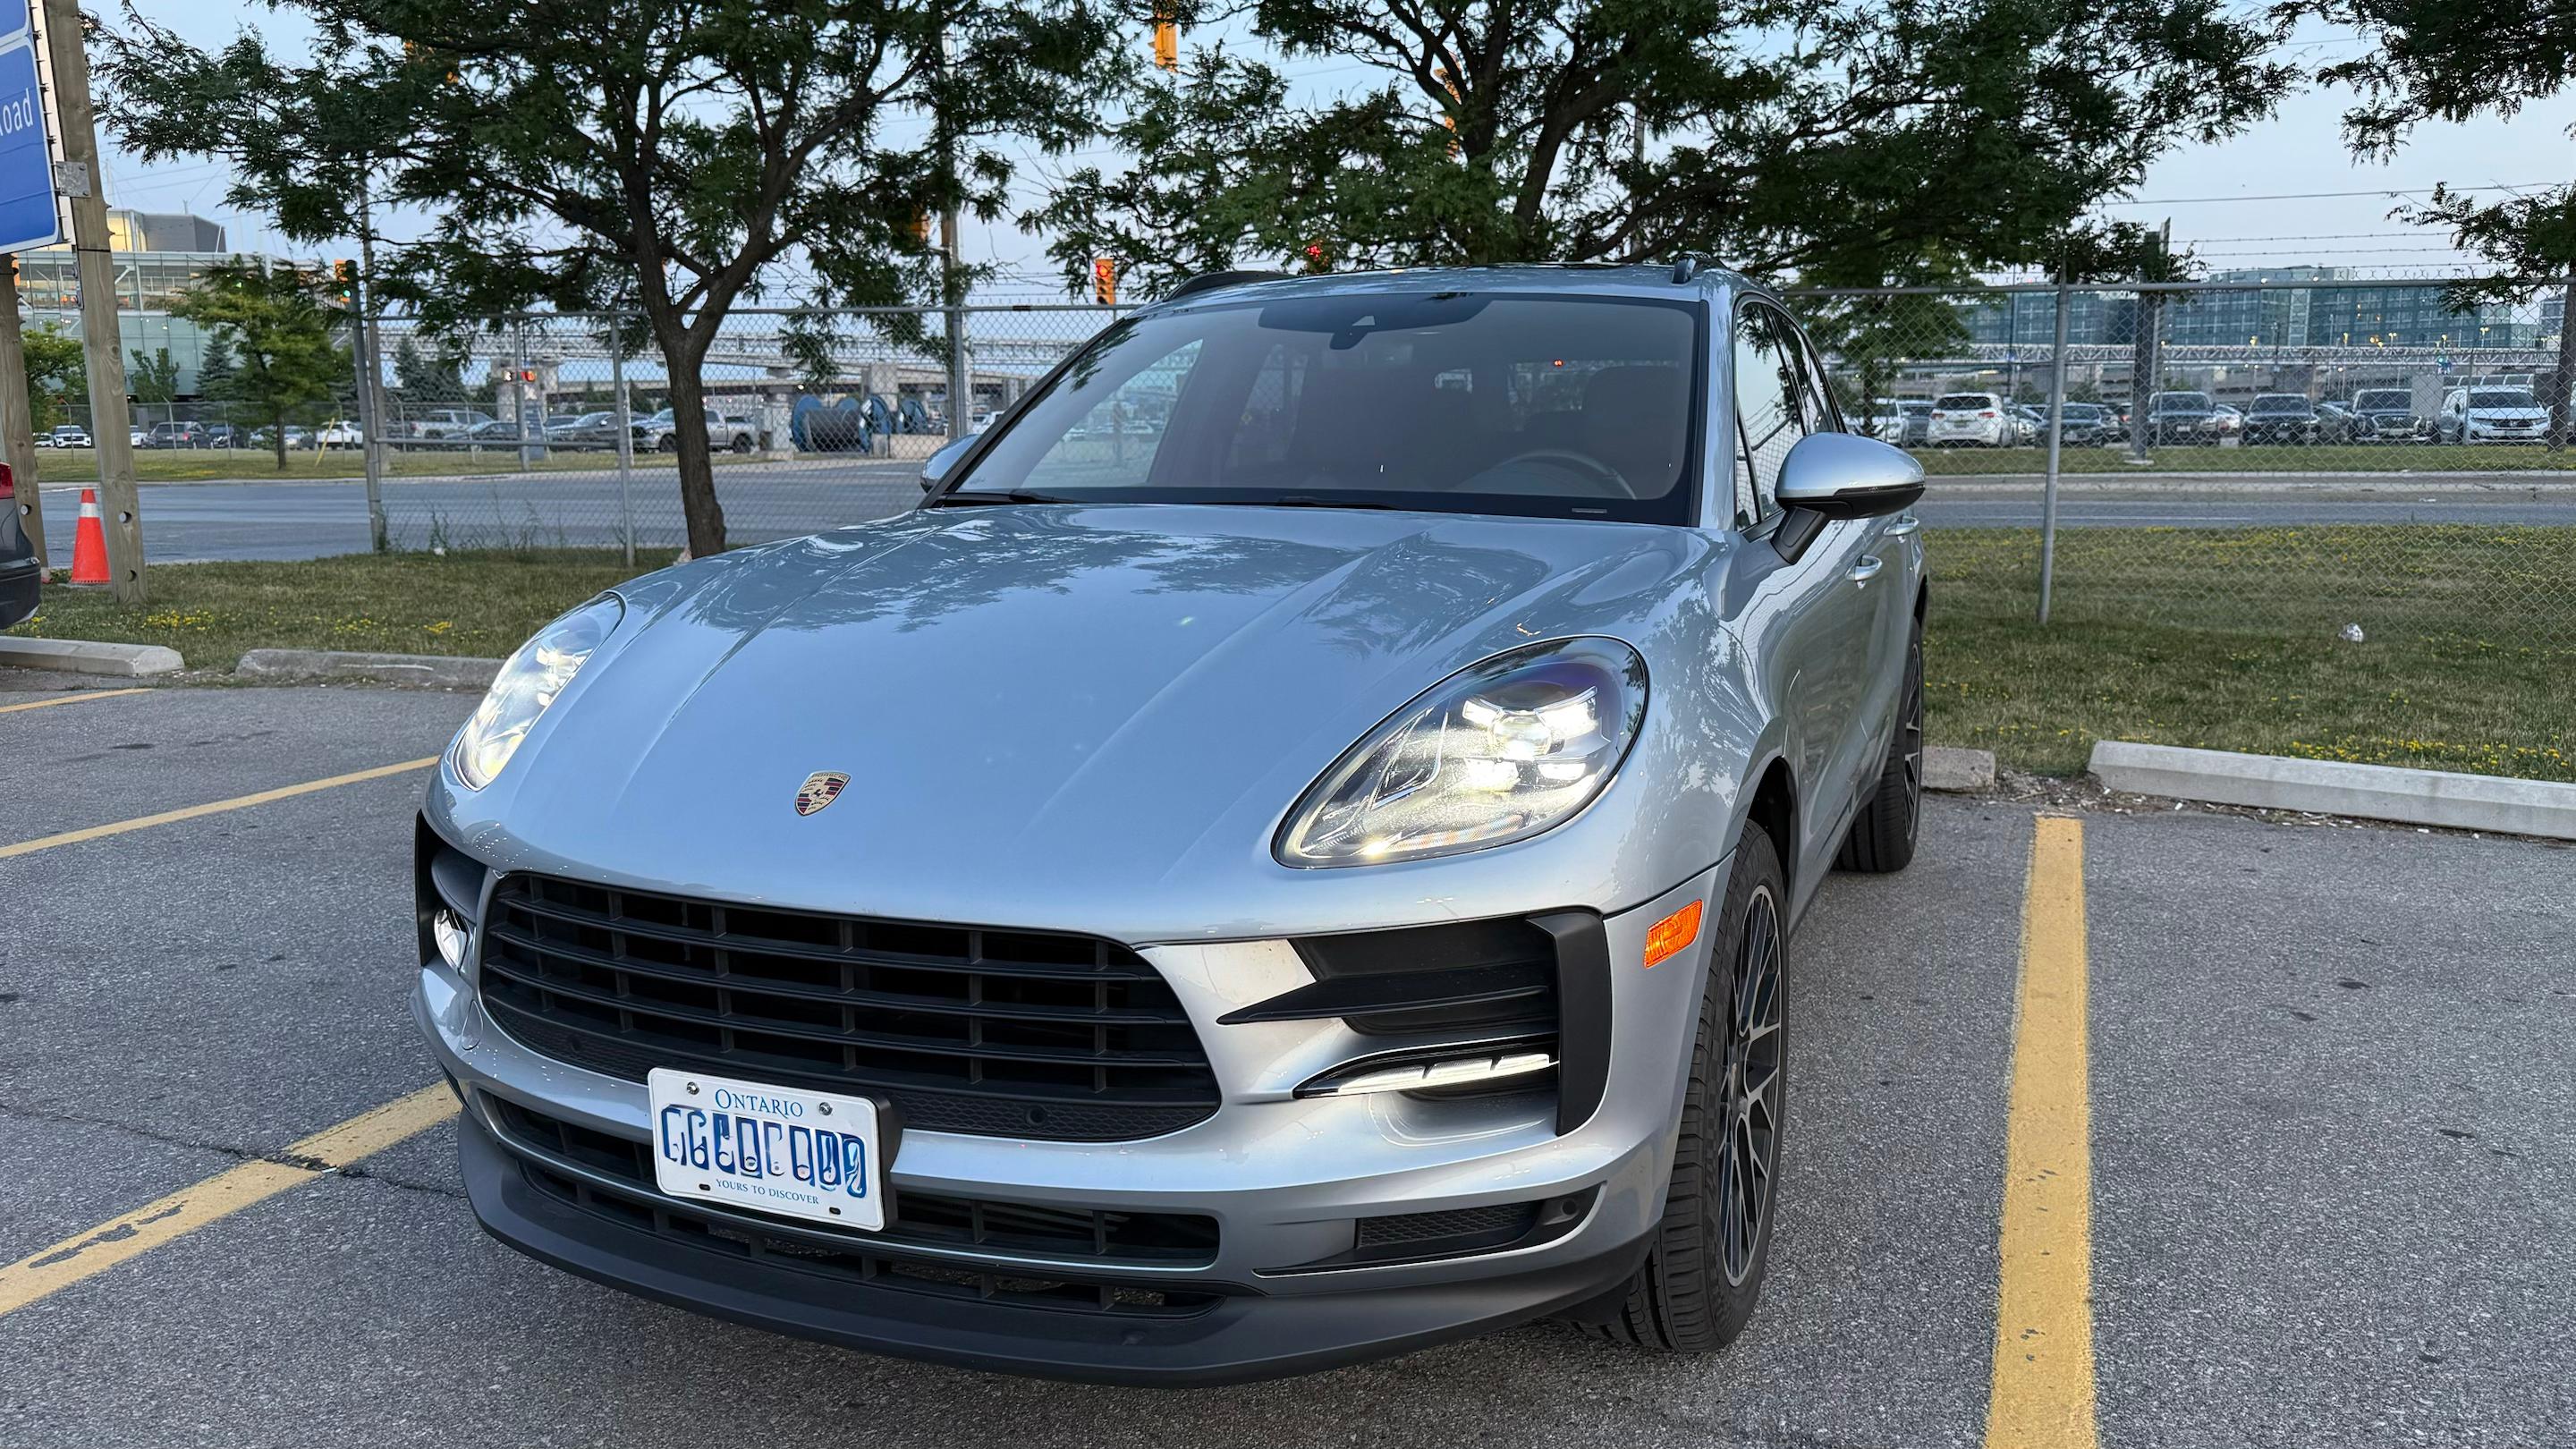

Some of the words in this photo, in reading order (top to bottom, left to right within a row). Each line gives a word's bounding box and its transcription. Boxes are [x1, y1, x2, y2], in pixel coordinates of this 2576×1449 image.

[0, 87, 33, 136] oad
[715, 1089, 803, 1119] ONTARIO
[716, 1178, 749, 1192] YOURS
[751, 1184, 766, 1195] TO
[768, 1189, 819, 1205] DISCOVER
